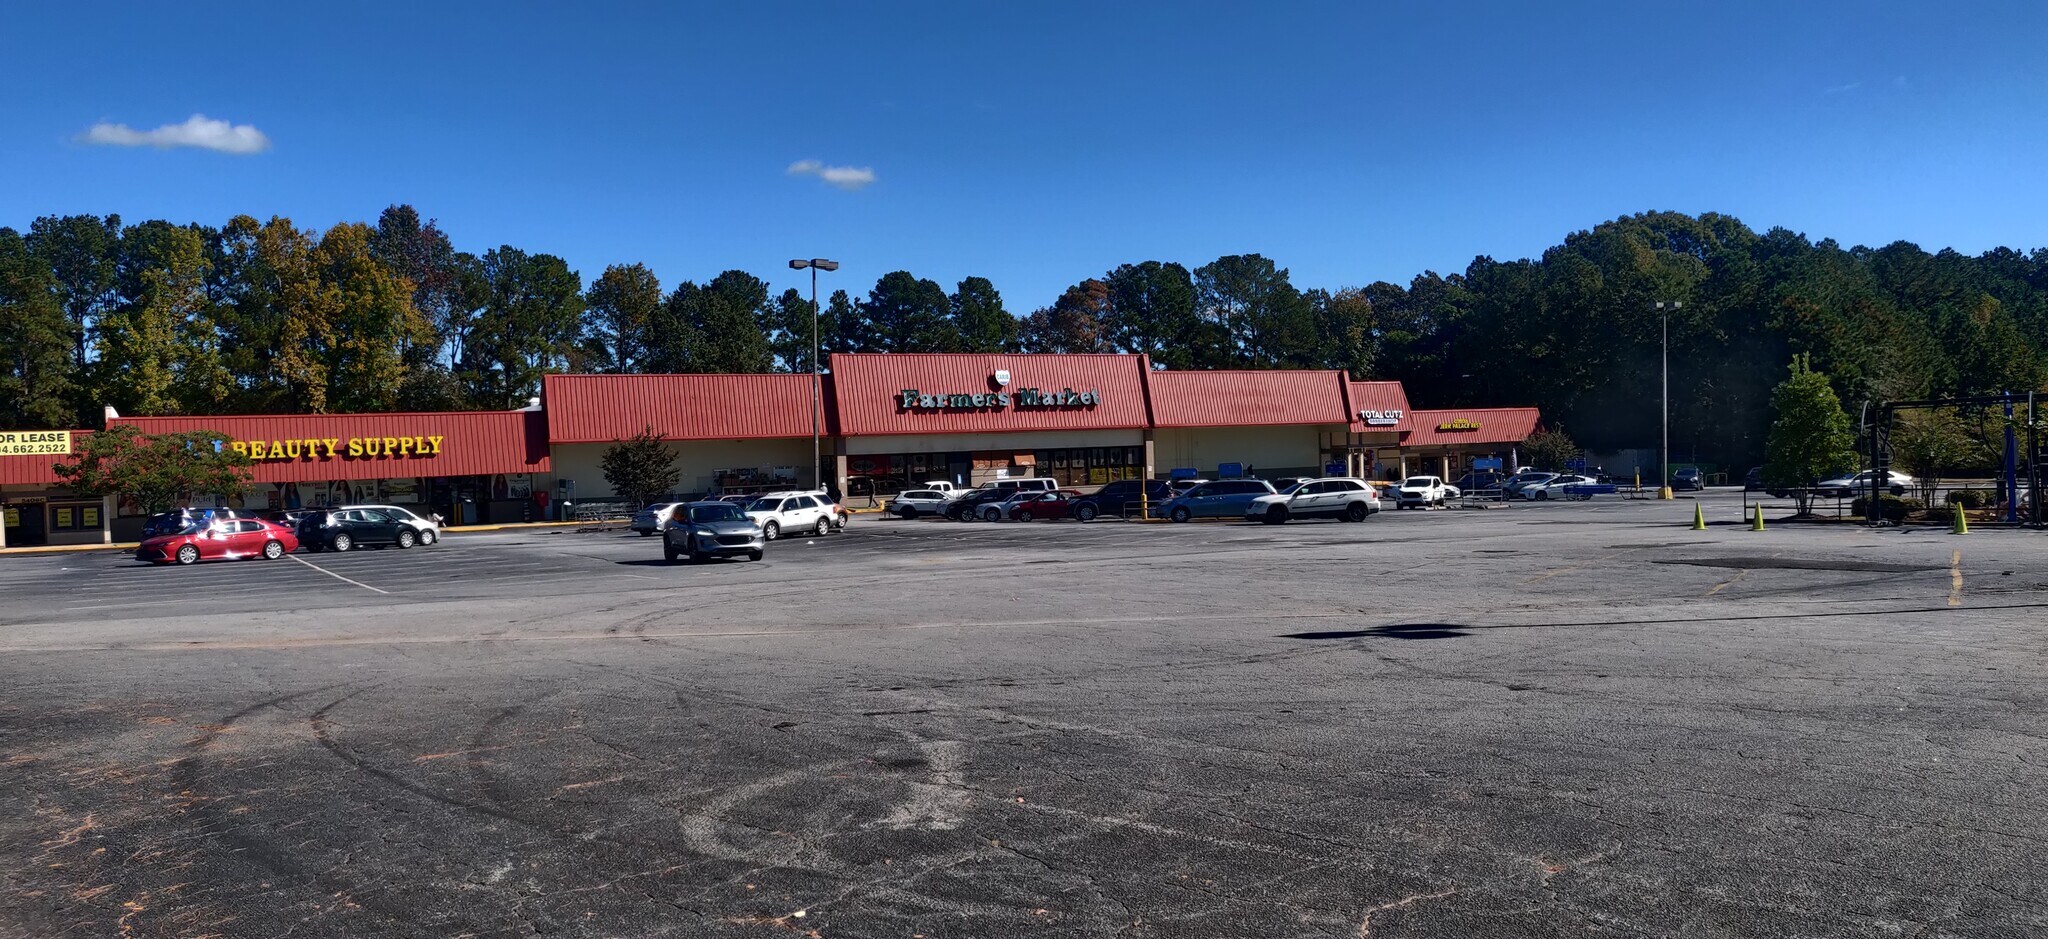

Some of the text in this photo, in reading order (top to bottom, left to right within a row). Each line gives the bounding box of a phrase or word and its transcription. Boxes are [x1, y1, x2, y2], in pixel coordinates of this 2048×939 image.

[901, 387, 1100, 408] Farmers Market
[1360, 410, 1403, 418] TOTAL CUTZ
[21, 433, 65, 442] LEASE
[0, 444, 66, 453] 4.662.2522
[231, 438, 339, 459] BEAUTY
[348, 436, 443, 456] SUPPLY
